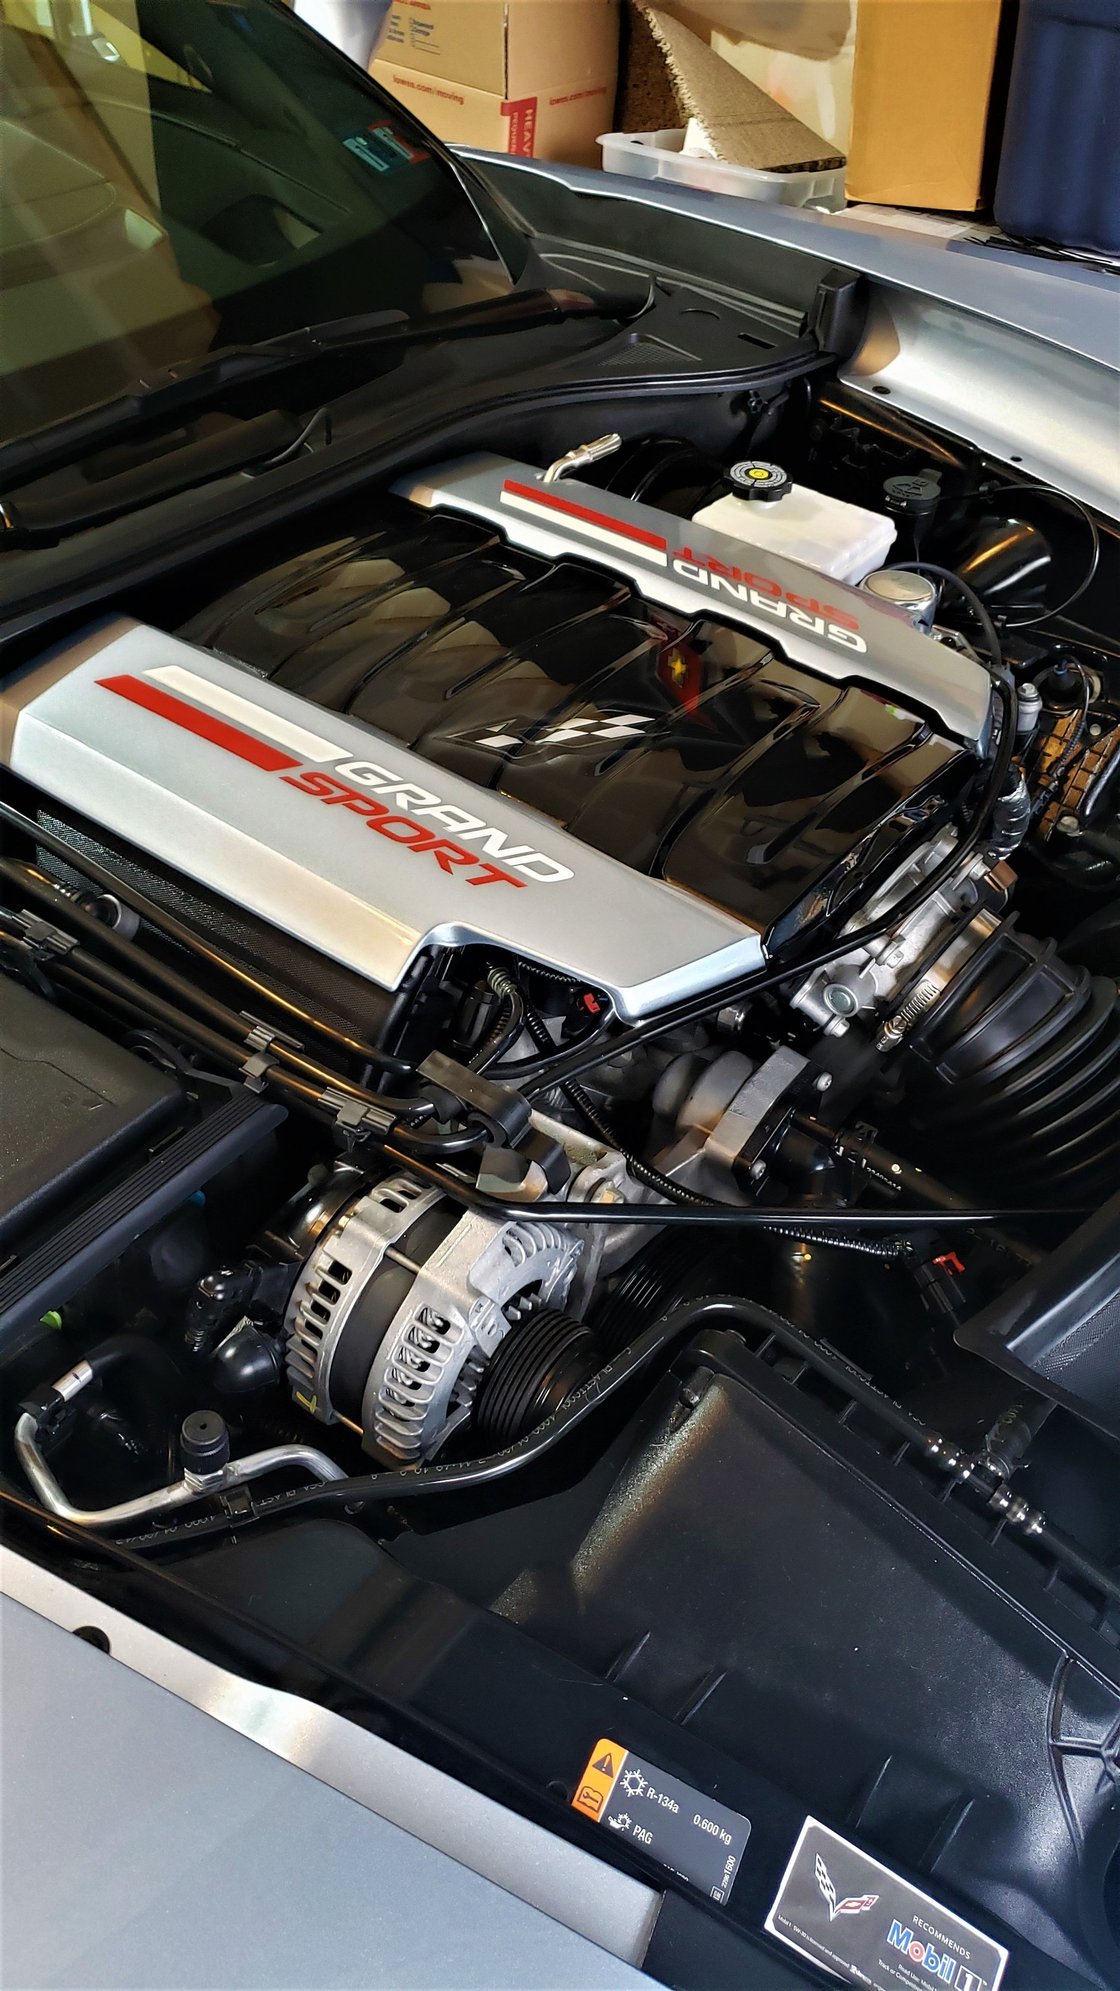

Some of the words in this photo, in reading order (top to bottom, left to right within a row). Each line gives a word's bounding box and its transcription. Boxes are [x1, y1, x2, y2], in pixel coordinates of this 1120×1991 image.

[672, 546, 860, 632] SPORT
[672, 558, 868, 654] GRAND
[278, 771, 529, 889] SPORT
[334, 761, 576, 883] GRAND
[646, 1787, 680, 1814] R-134a
[693, 1814, 720, 1837] 0.600
[719, 1828, 732, 1845] kg
[632, 1824, 654, 1845] PAG
[886, 1918, 957, 1985] Mobil
[912, 1915, 972, 1960] RECOMMENDS
